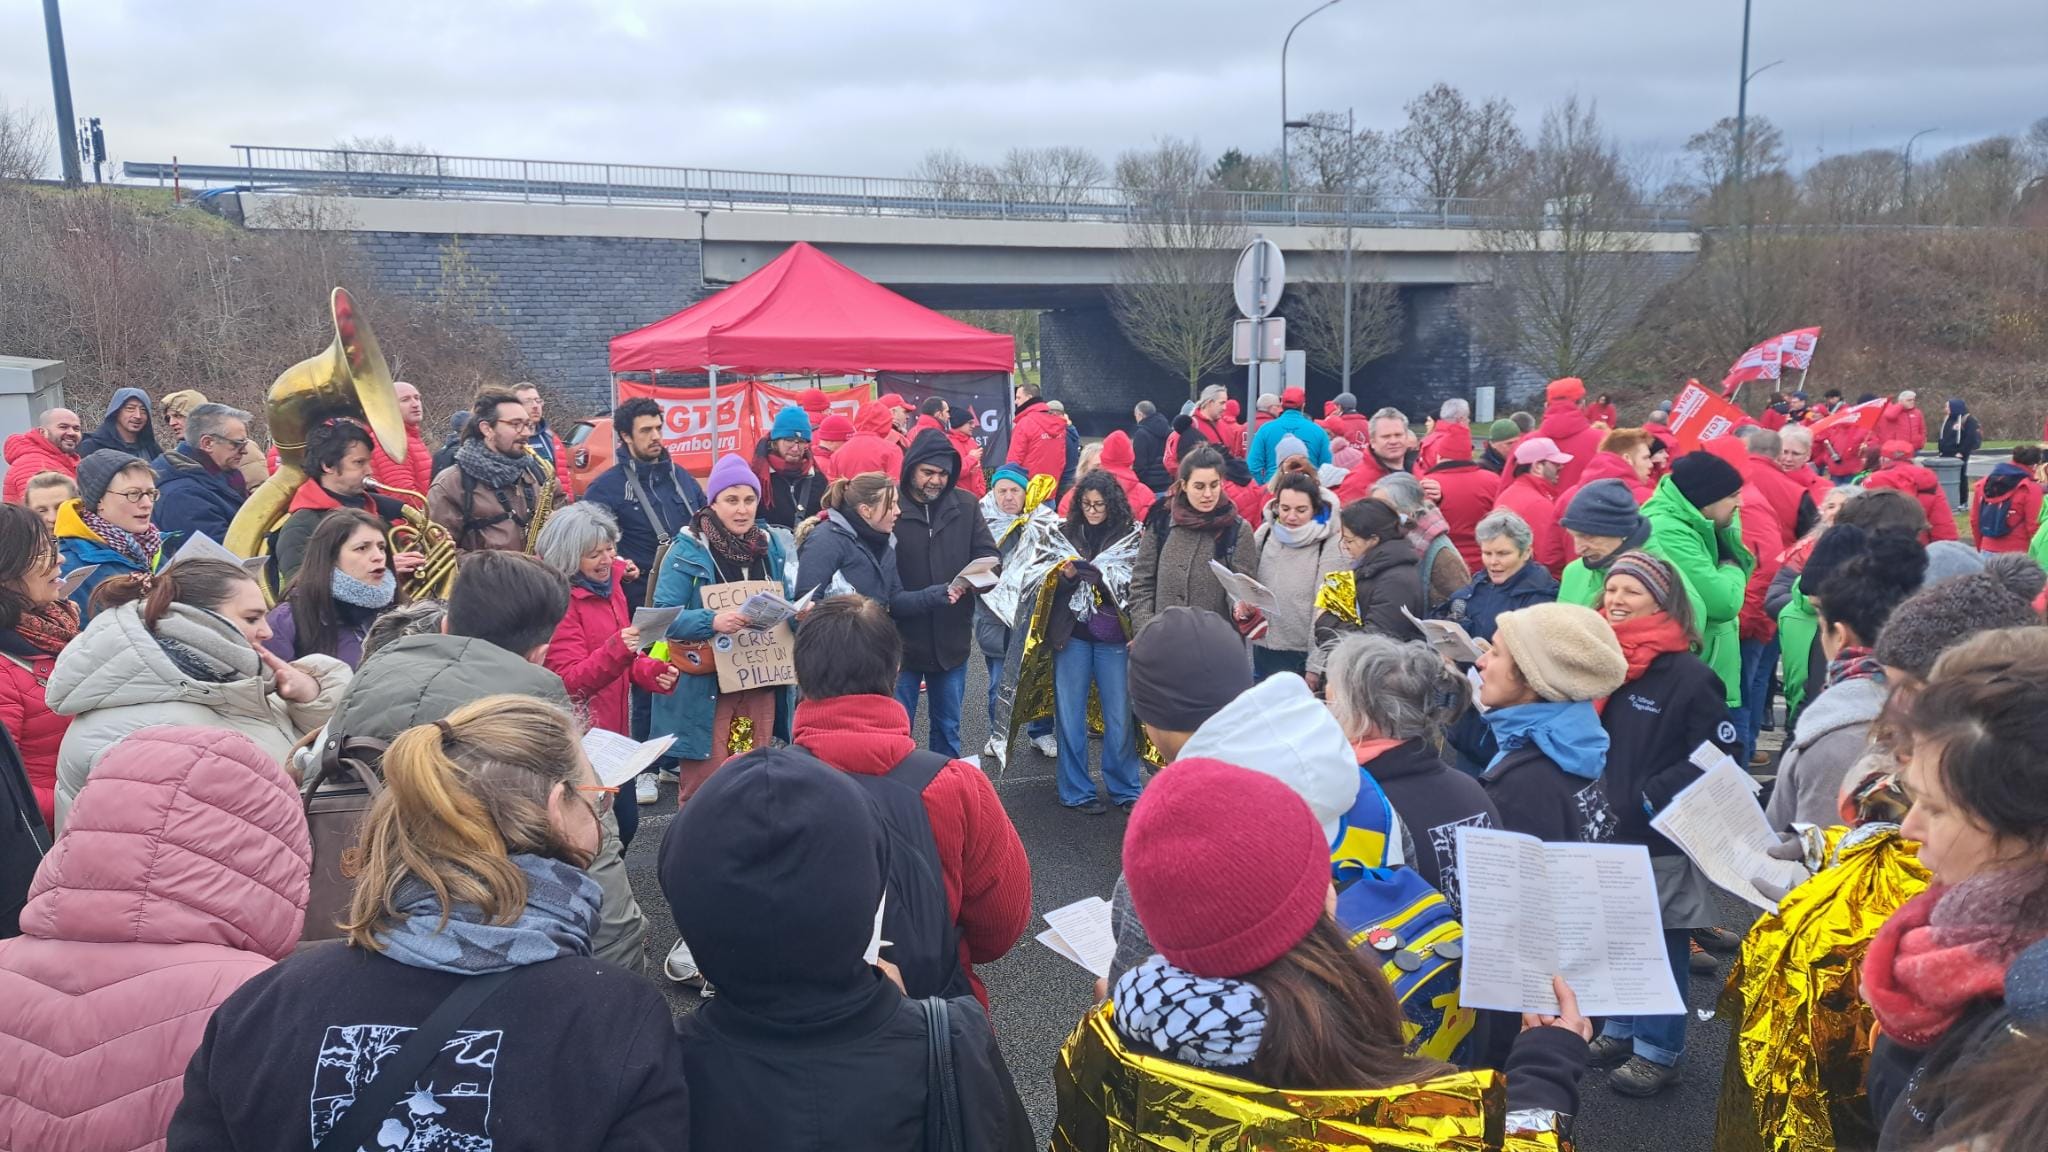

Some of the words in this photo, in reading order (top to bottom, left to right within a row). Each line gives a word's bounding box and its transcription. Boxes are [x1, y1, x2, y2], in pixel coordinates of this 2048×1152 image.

[660, 400, 737, 433] GTB
[663, 435, 736, 453] emborg
[737, 631, 776, 648] CRISE
[731, 649, 769, 667] C'EST
[773, 647, 787, 661] UN
